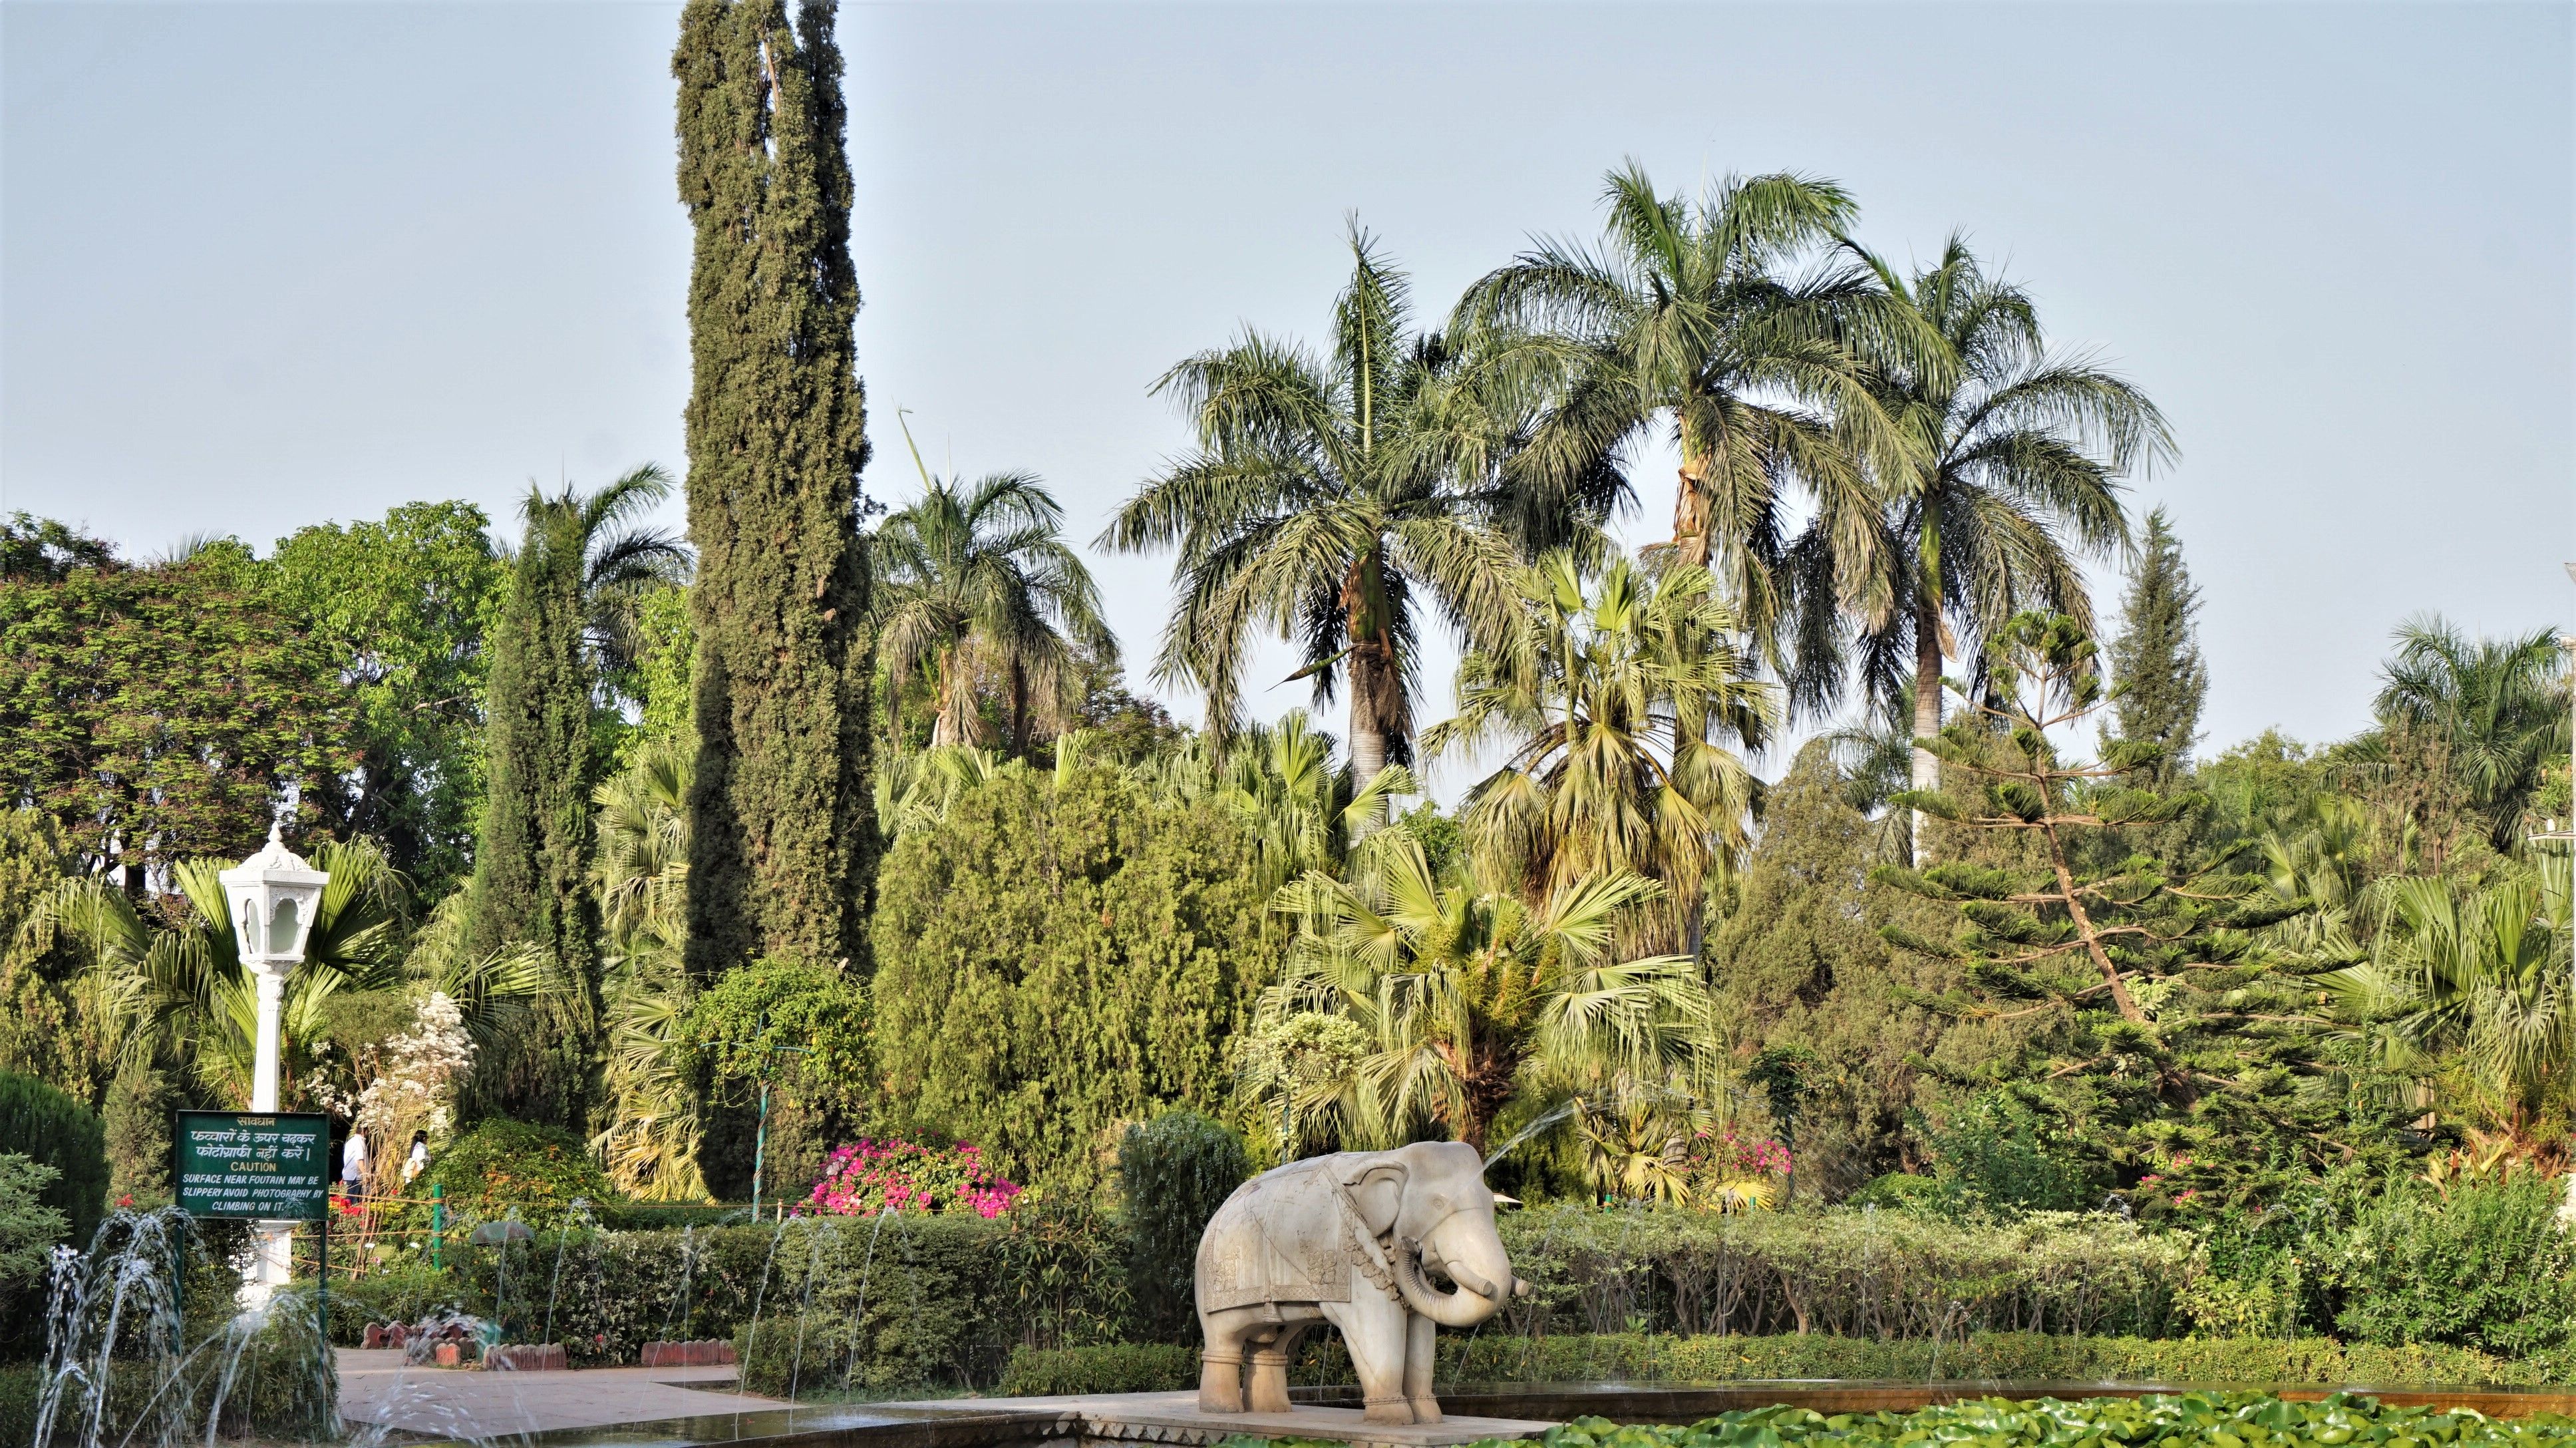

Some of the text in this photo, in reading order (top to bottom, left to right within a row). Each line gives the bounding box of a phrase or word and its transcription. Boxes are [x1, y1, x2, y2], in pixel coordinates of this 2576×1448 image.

[237, 1117, 276, 1127] सावधान
[237, 1130, 250, 1142] के
[253, 1133, 279, 1143] ऊपर
[256, 1145, 277, 1161] नहीं
[231, 1162, 276, 1172] CAUTION
[183, 1175, 222, 1184] SURFACE
[224, 1175, 247, 1184] NEAR
[249, 1176, 285, 1184] FOUTAIN
[287, 1176, 305, 1184] MAY
[183, 1187, 222, 1196] SLIPPERY
[252, 1189, 311, 1198] PHOTOGRAPHY
[212, 1202, 255, 1211] CLIMBING
[258, 1202, 271, 1211] ON
